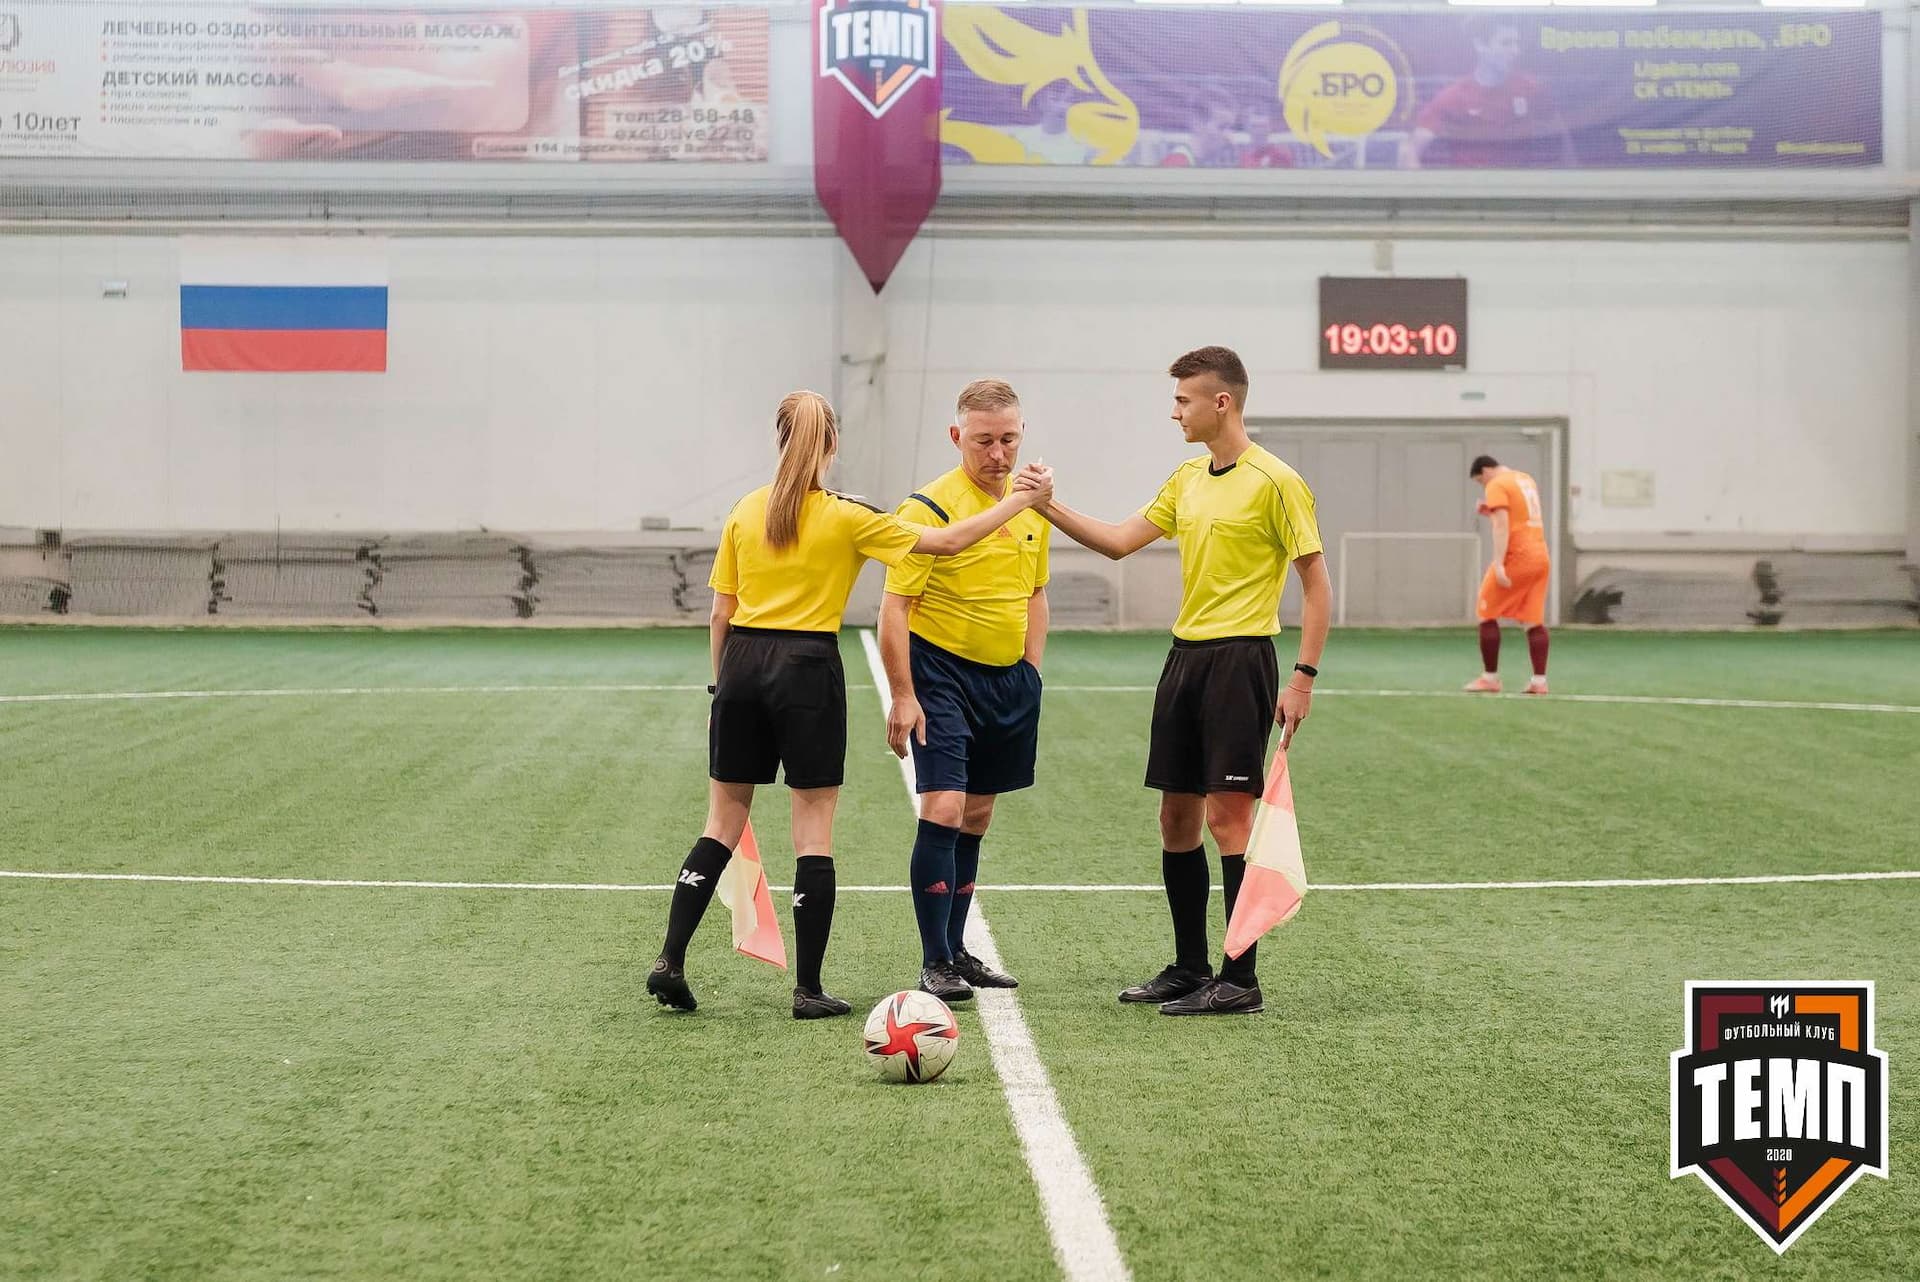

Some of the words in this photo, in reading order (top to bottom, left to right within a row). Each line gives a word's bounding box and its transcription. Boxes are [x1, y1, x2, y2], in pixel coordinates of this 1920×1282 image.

[671, 33, 733, 68] 20%
[832, 10, 924, 60] ТЕМП
[102, 69, 198, 87] ДЕТСКИЙ
[1312, 73, 1385, 97] .БРО
[1325, 323, 1457, 355] 19:03:10
